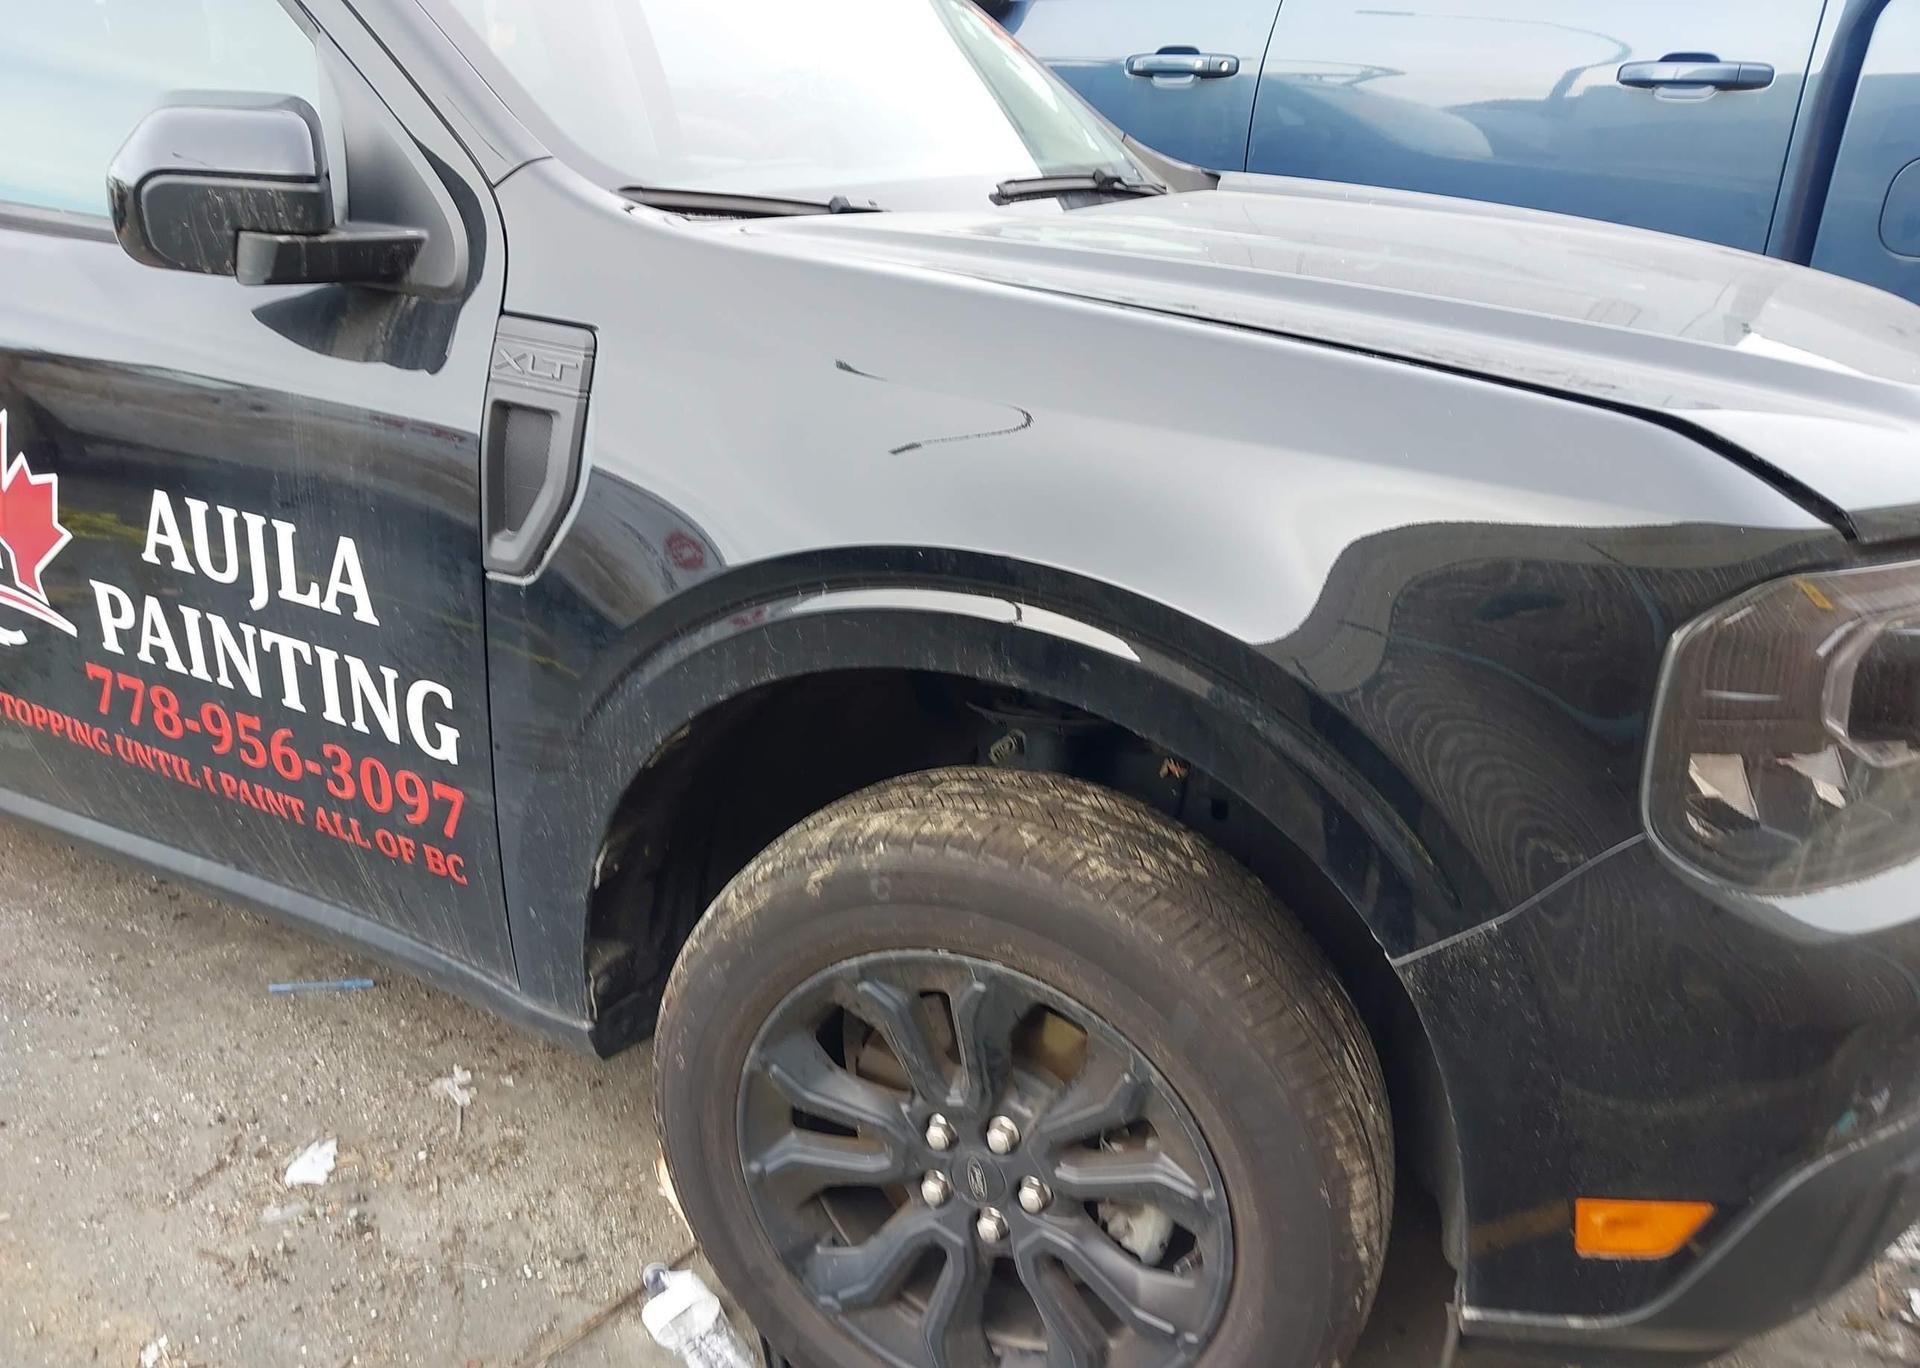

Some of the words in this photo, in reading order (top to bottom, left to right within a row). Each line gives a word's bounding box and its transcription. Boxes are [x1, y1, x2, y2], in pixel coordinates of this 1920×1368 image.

[494, 348, 578, 381] XLT
[141, 489, 380, 627] AUJLA
[85, 661, 465, 839] 778-956-3097
[89, 579, 460, 766] PAINTING
[0, 691, 112, 756] TOPPING
[114, 733, 201, 789] UNTIL
[202, 765, 217, 794] I
[219, 771, 306, 825] PAINT
[315, 806, 371, 849] ALL
[375, 828, 416, 864] OF
[423, 843, 468, 886] BC
